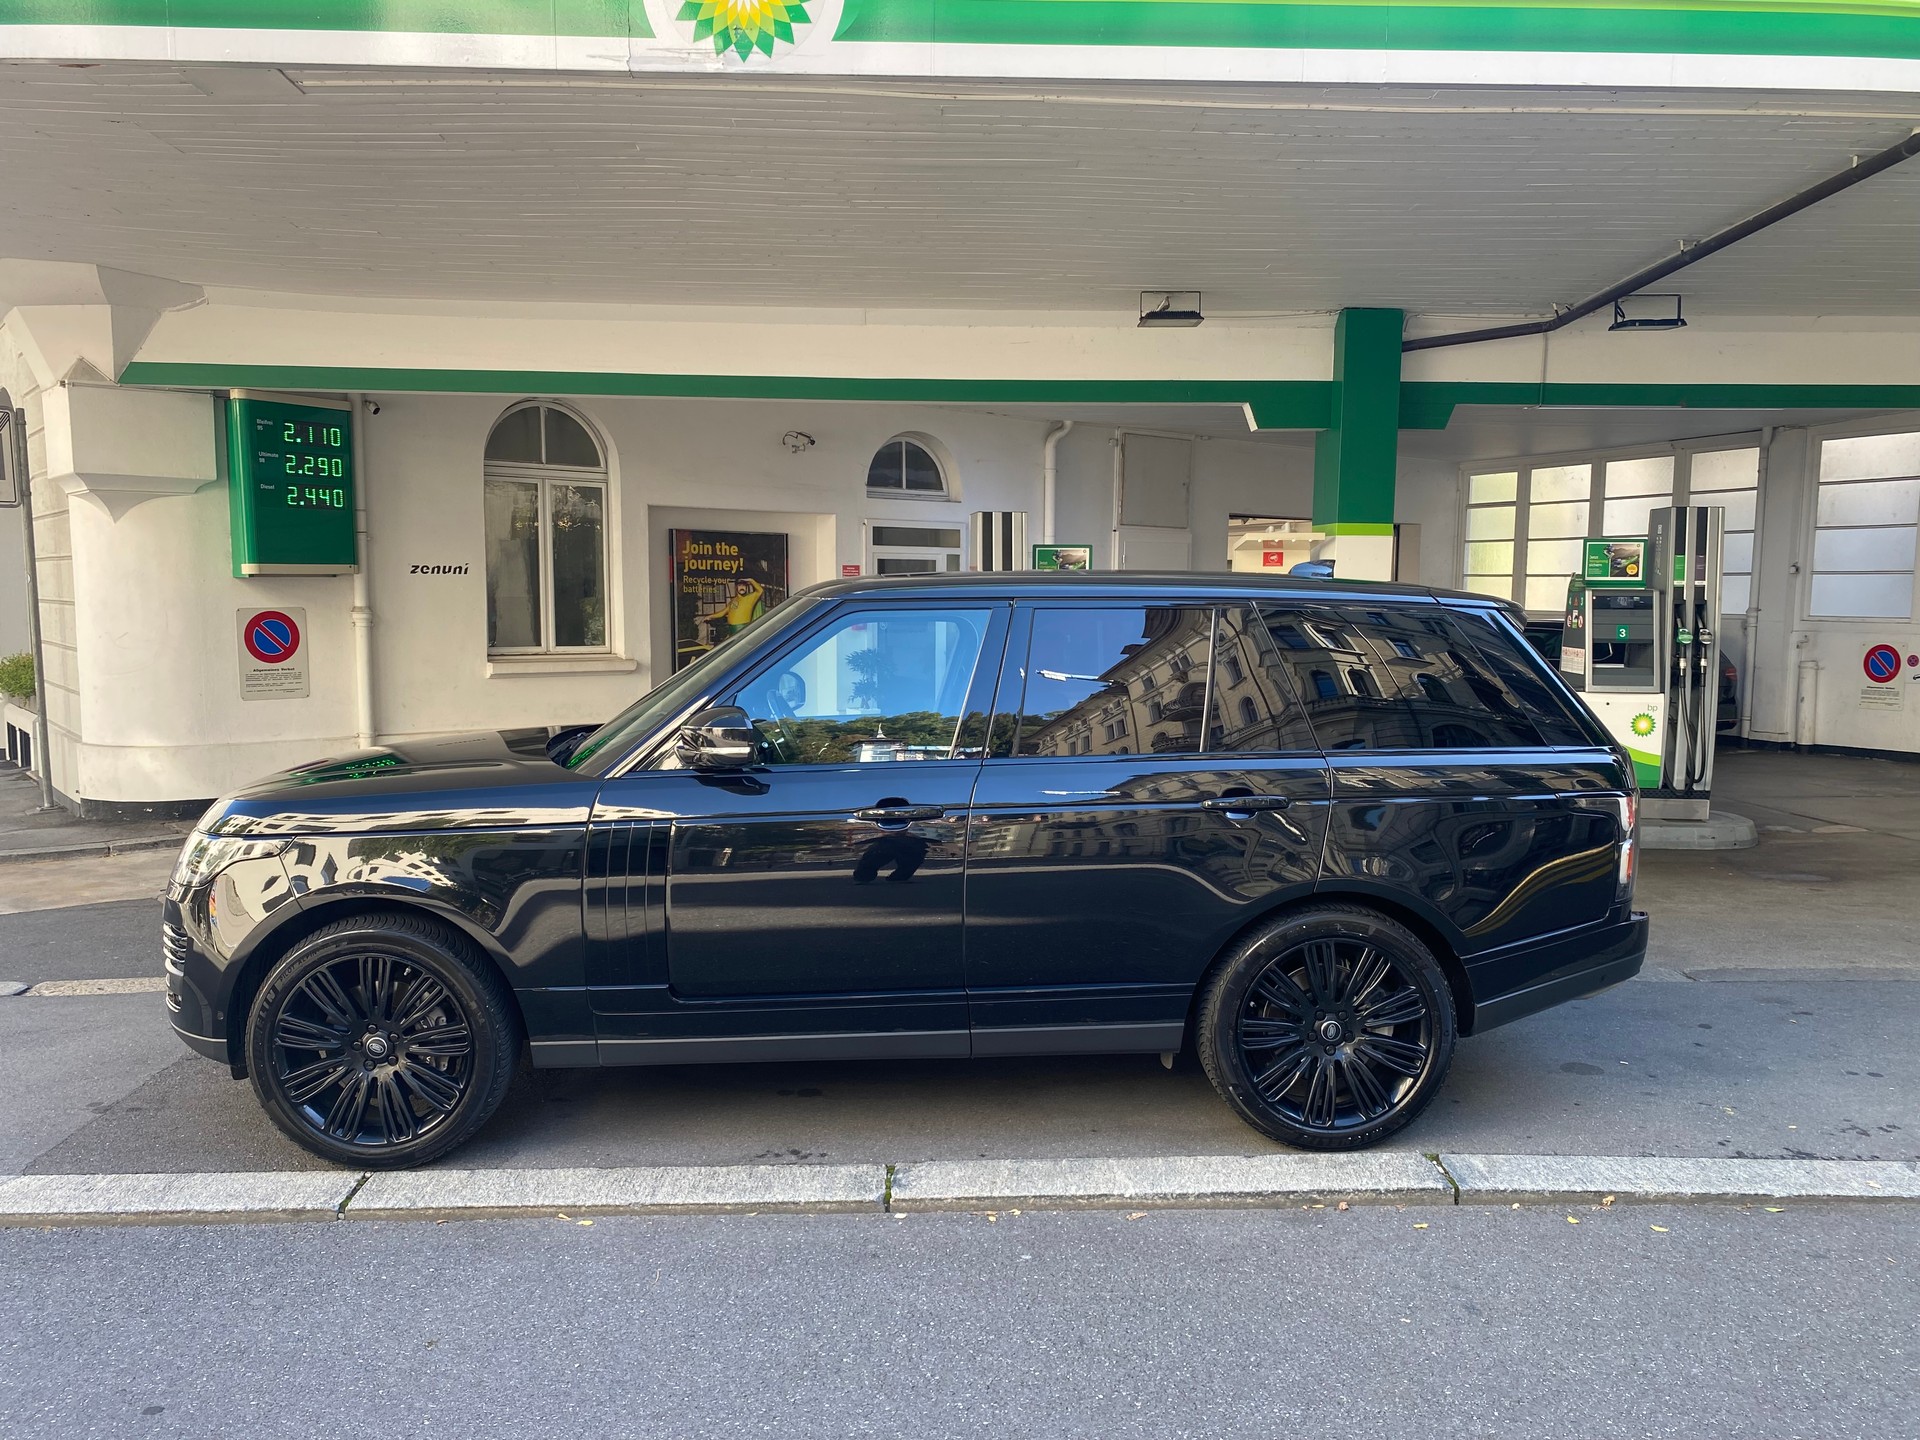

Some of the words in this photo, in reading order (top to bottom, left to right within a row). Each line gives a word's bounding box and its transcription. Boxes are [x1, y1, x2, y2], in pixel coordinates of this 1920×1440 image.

[284, 422, 341, 446] 2.110
[286, 454, 342, 477] 2.290
[287, 486, 343, 508] 2.440
[682, 540, 712, 555] Join
[715, 542, 739, 555] the
[410, 562, 469, 575] zenuni
[683, 556, 744, 573] journey!
[683, 575, 712, 585] Recycle
[713, 577, 731, 586] your
[683, 585, 719, 593] batteries.
[1619, 628, 1627, 638] 3
[1647, 704, 1659, 712] bp
